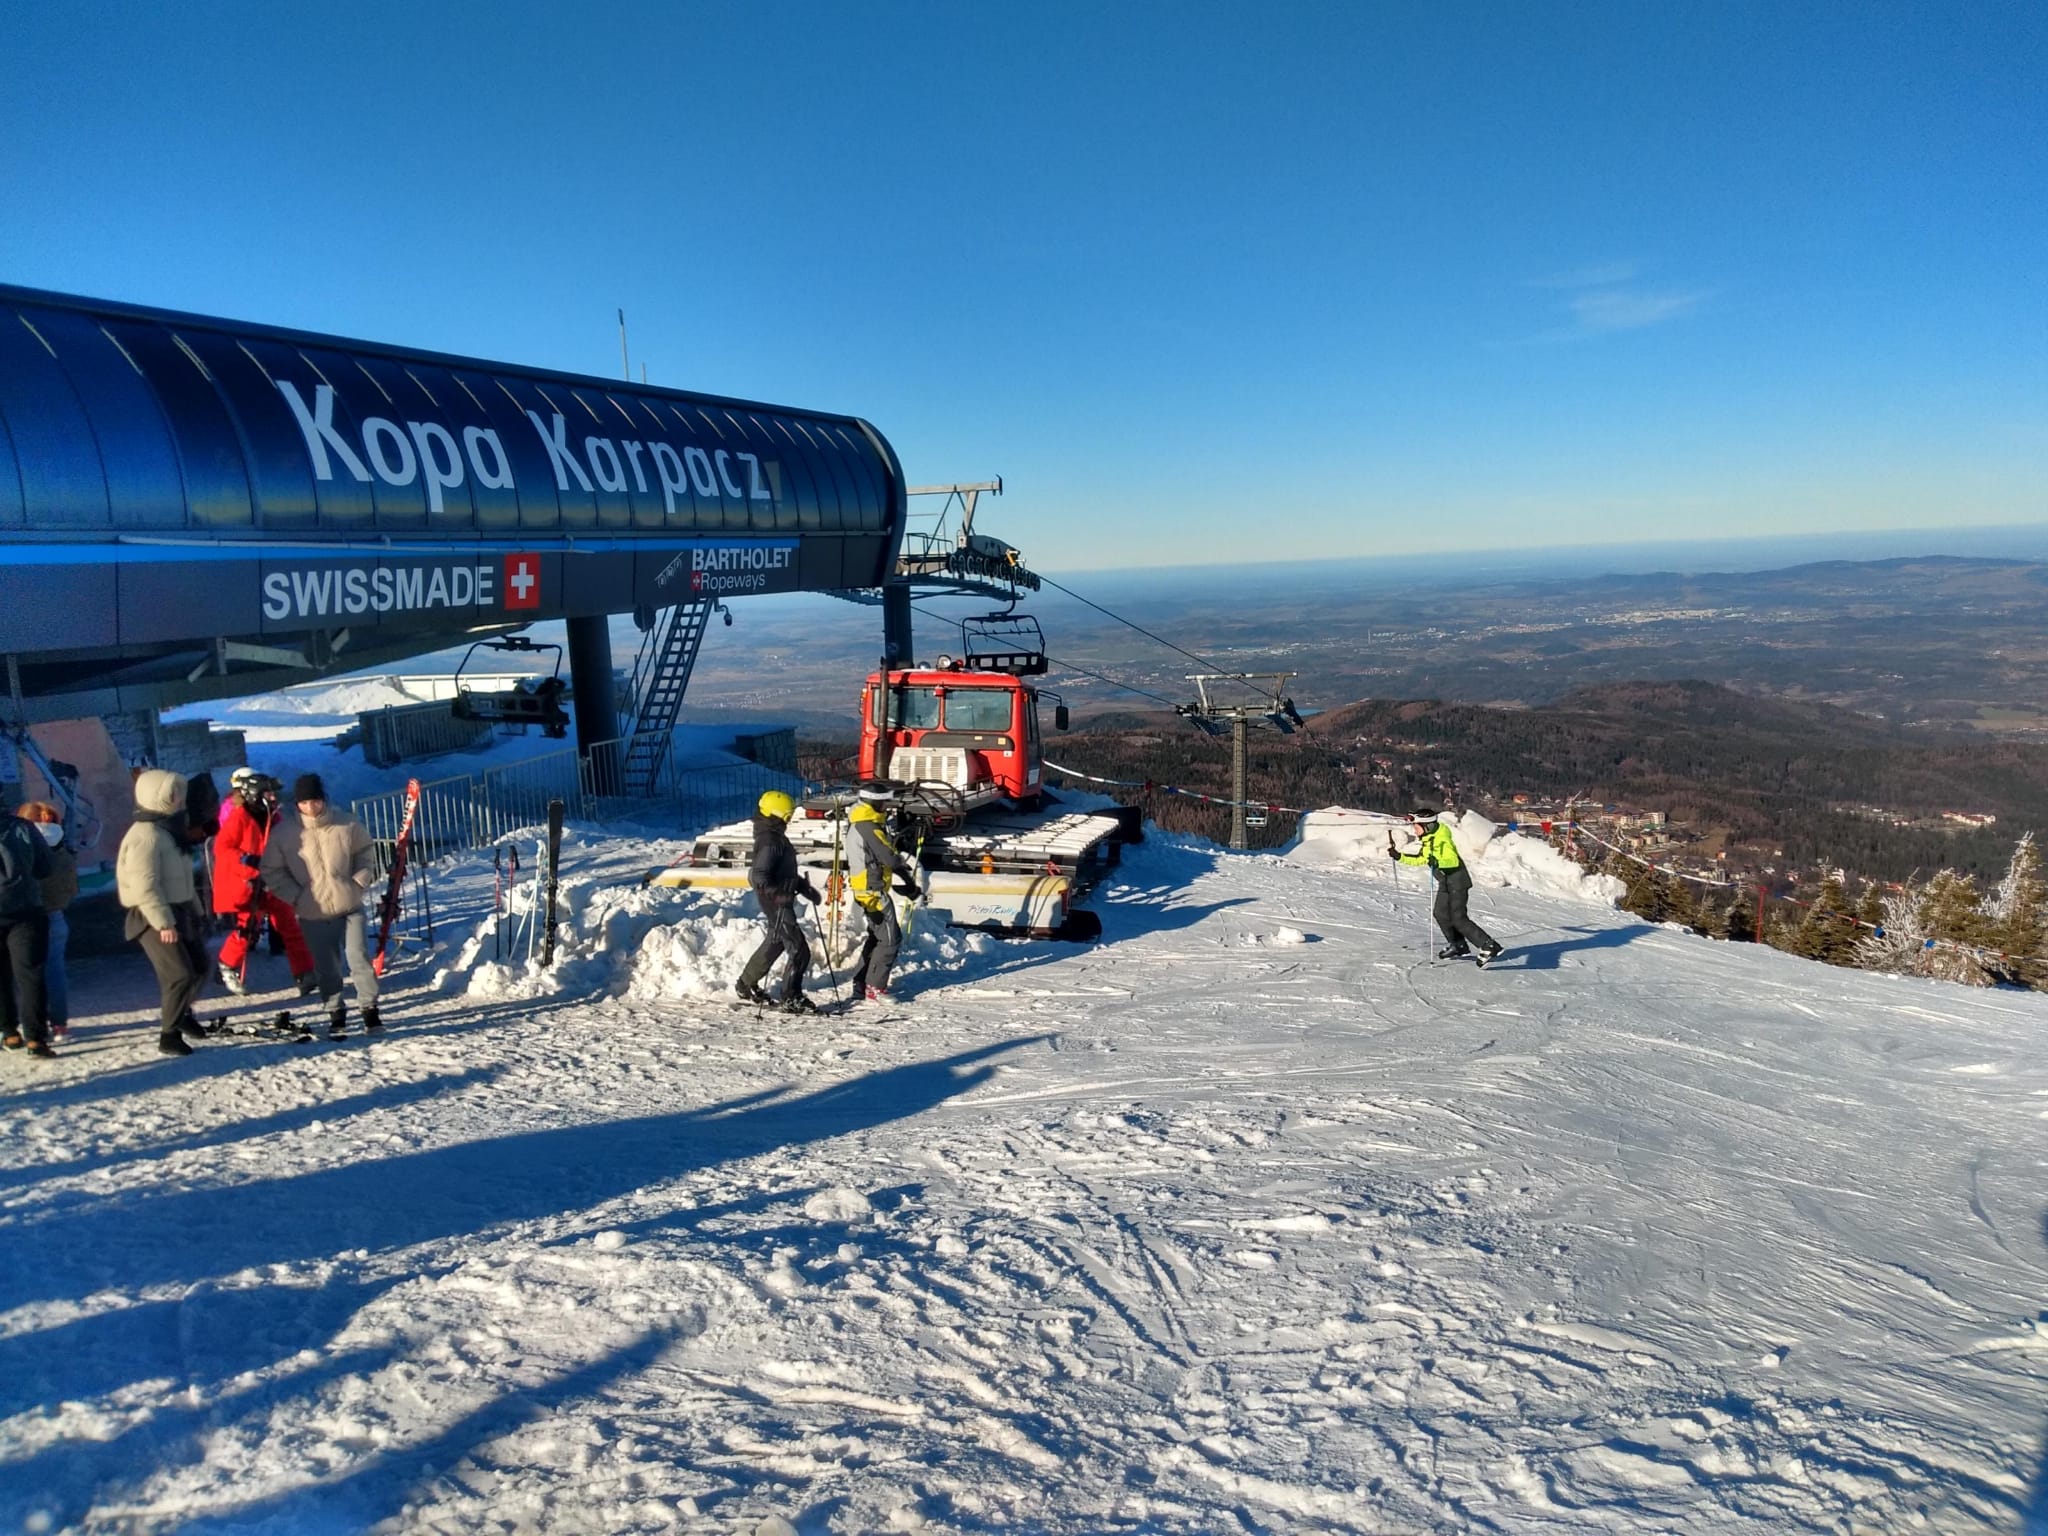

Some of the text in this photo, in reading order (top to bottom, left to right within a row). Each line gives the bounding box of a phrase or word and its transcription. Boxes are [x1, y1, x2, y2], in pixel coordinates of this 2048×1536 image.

[275, 379, 771, 514] Kopa Karpacz
[692, 547, 792, 571] BARTHOLET
[262, 565, 494, 620] SWISSMADE
[701, 572, 766, 593] Ropeways
